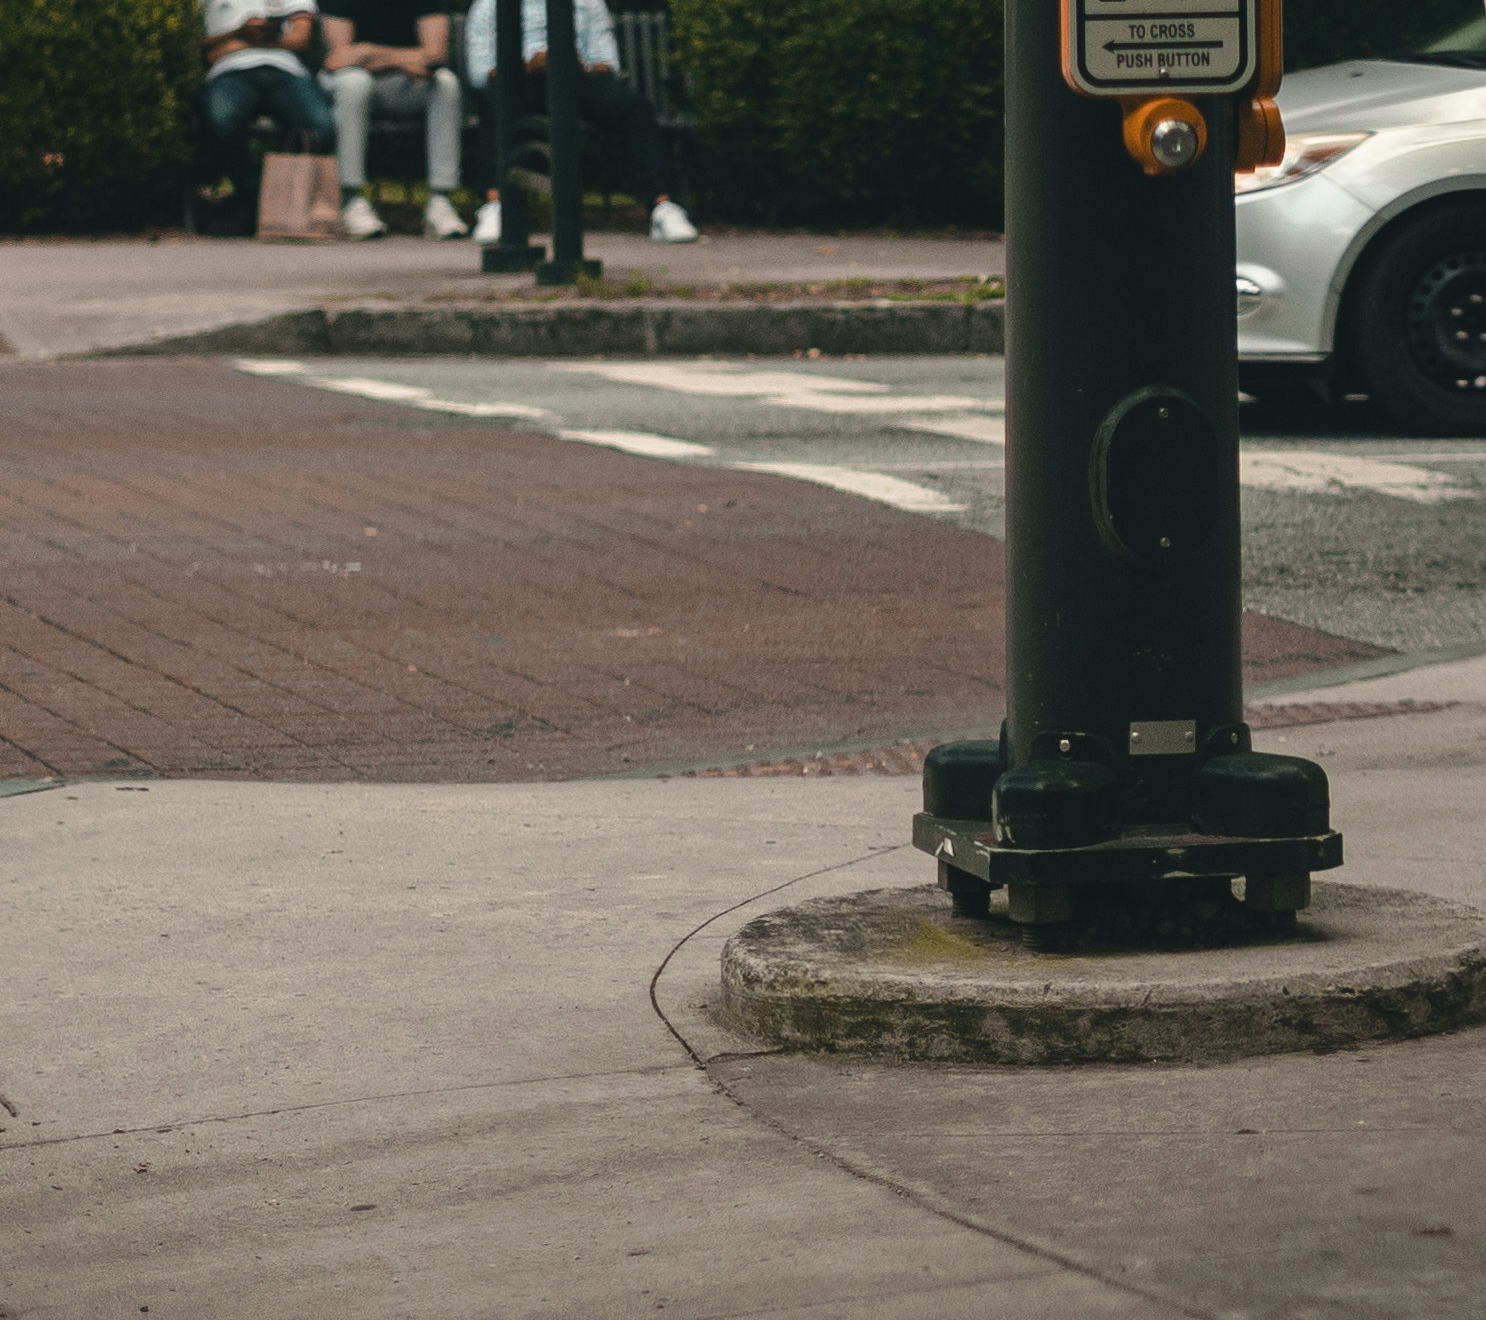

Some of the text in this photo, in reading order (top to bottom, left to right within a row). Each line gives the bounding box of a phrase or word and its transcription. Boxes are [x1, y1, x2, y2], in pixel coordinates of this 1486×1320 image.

[1128, 23, 1195, 39] TO CROSS
[1117, 51, 1210, 68] PUSH BUTTON
